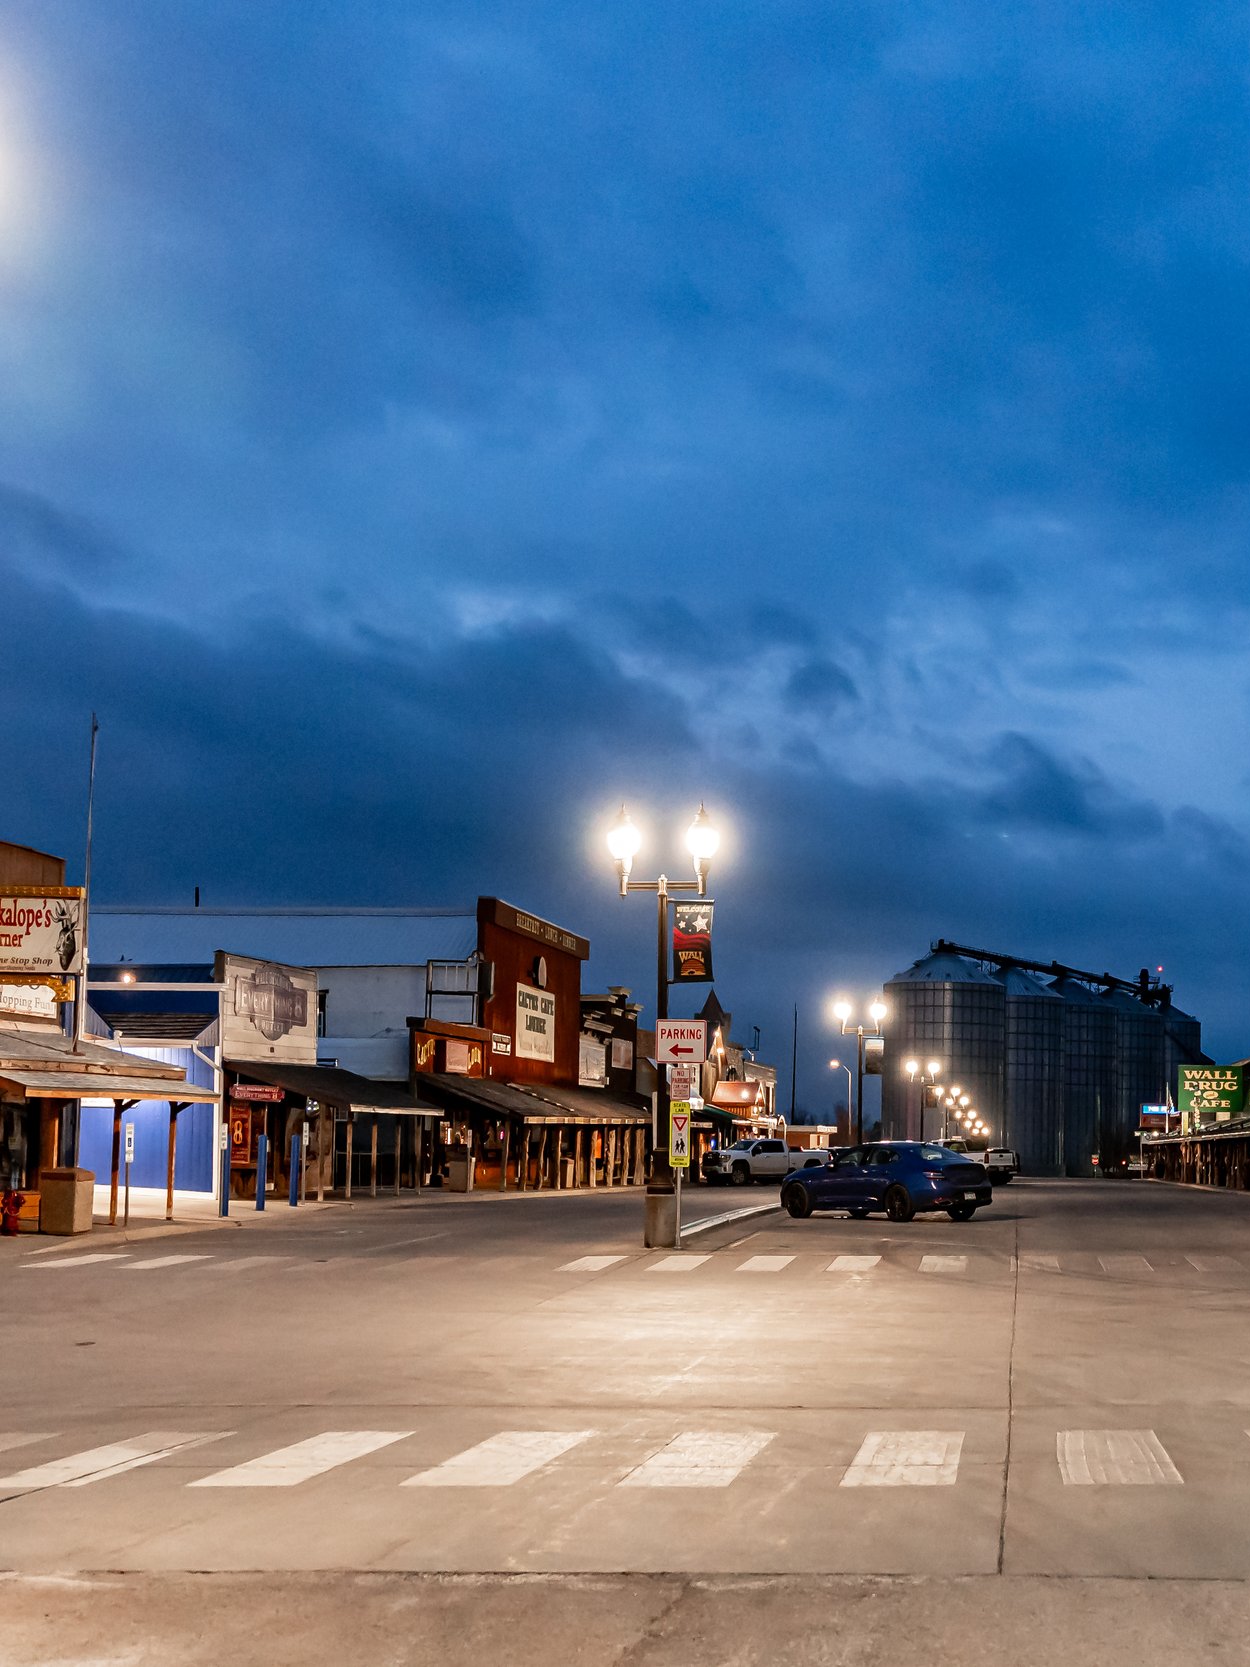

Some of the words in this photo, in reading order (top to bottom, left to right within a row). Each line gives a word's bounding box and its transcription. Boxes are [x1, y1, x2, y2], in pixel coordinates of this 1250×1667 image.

[676, 905, 711, 913] WELCOME
[10, 957, 30, 965] Stop
[31, 957, 53, 966] Shop
[678, 951, 705, 964] WALL
[518, 990, 539, 1012] CACTUS
[660, 1028, 702, 1040] PARKING
[1183, 1069, 1238, 1080] WALL
[1183, 1080, 1239, 1091] DRUG
[1189, 1099, 1231, 1109] CAFE
[233, 1120, 243, 1145] 8
